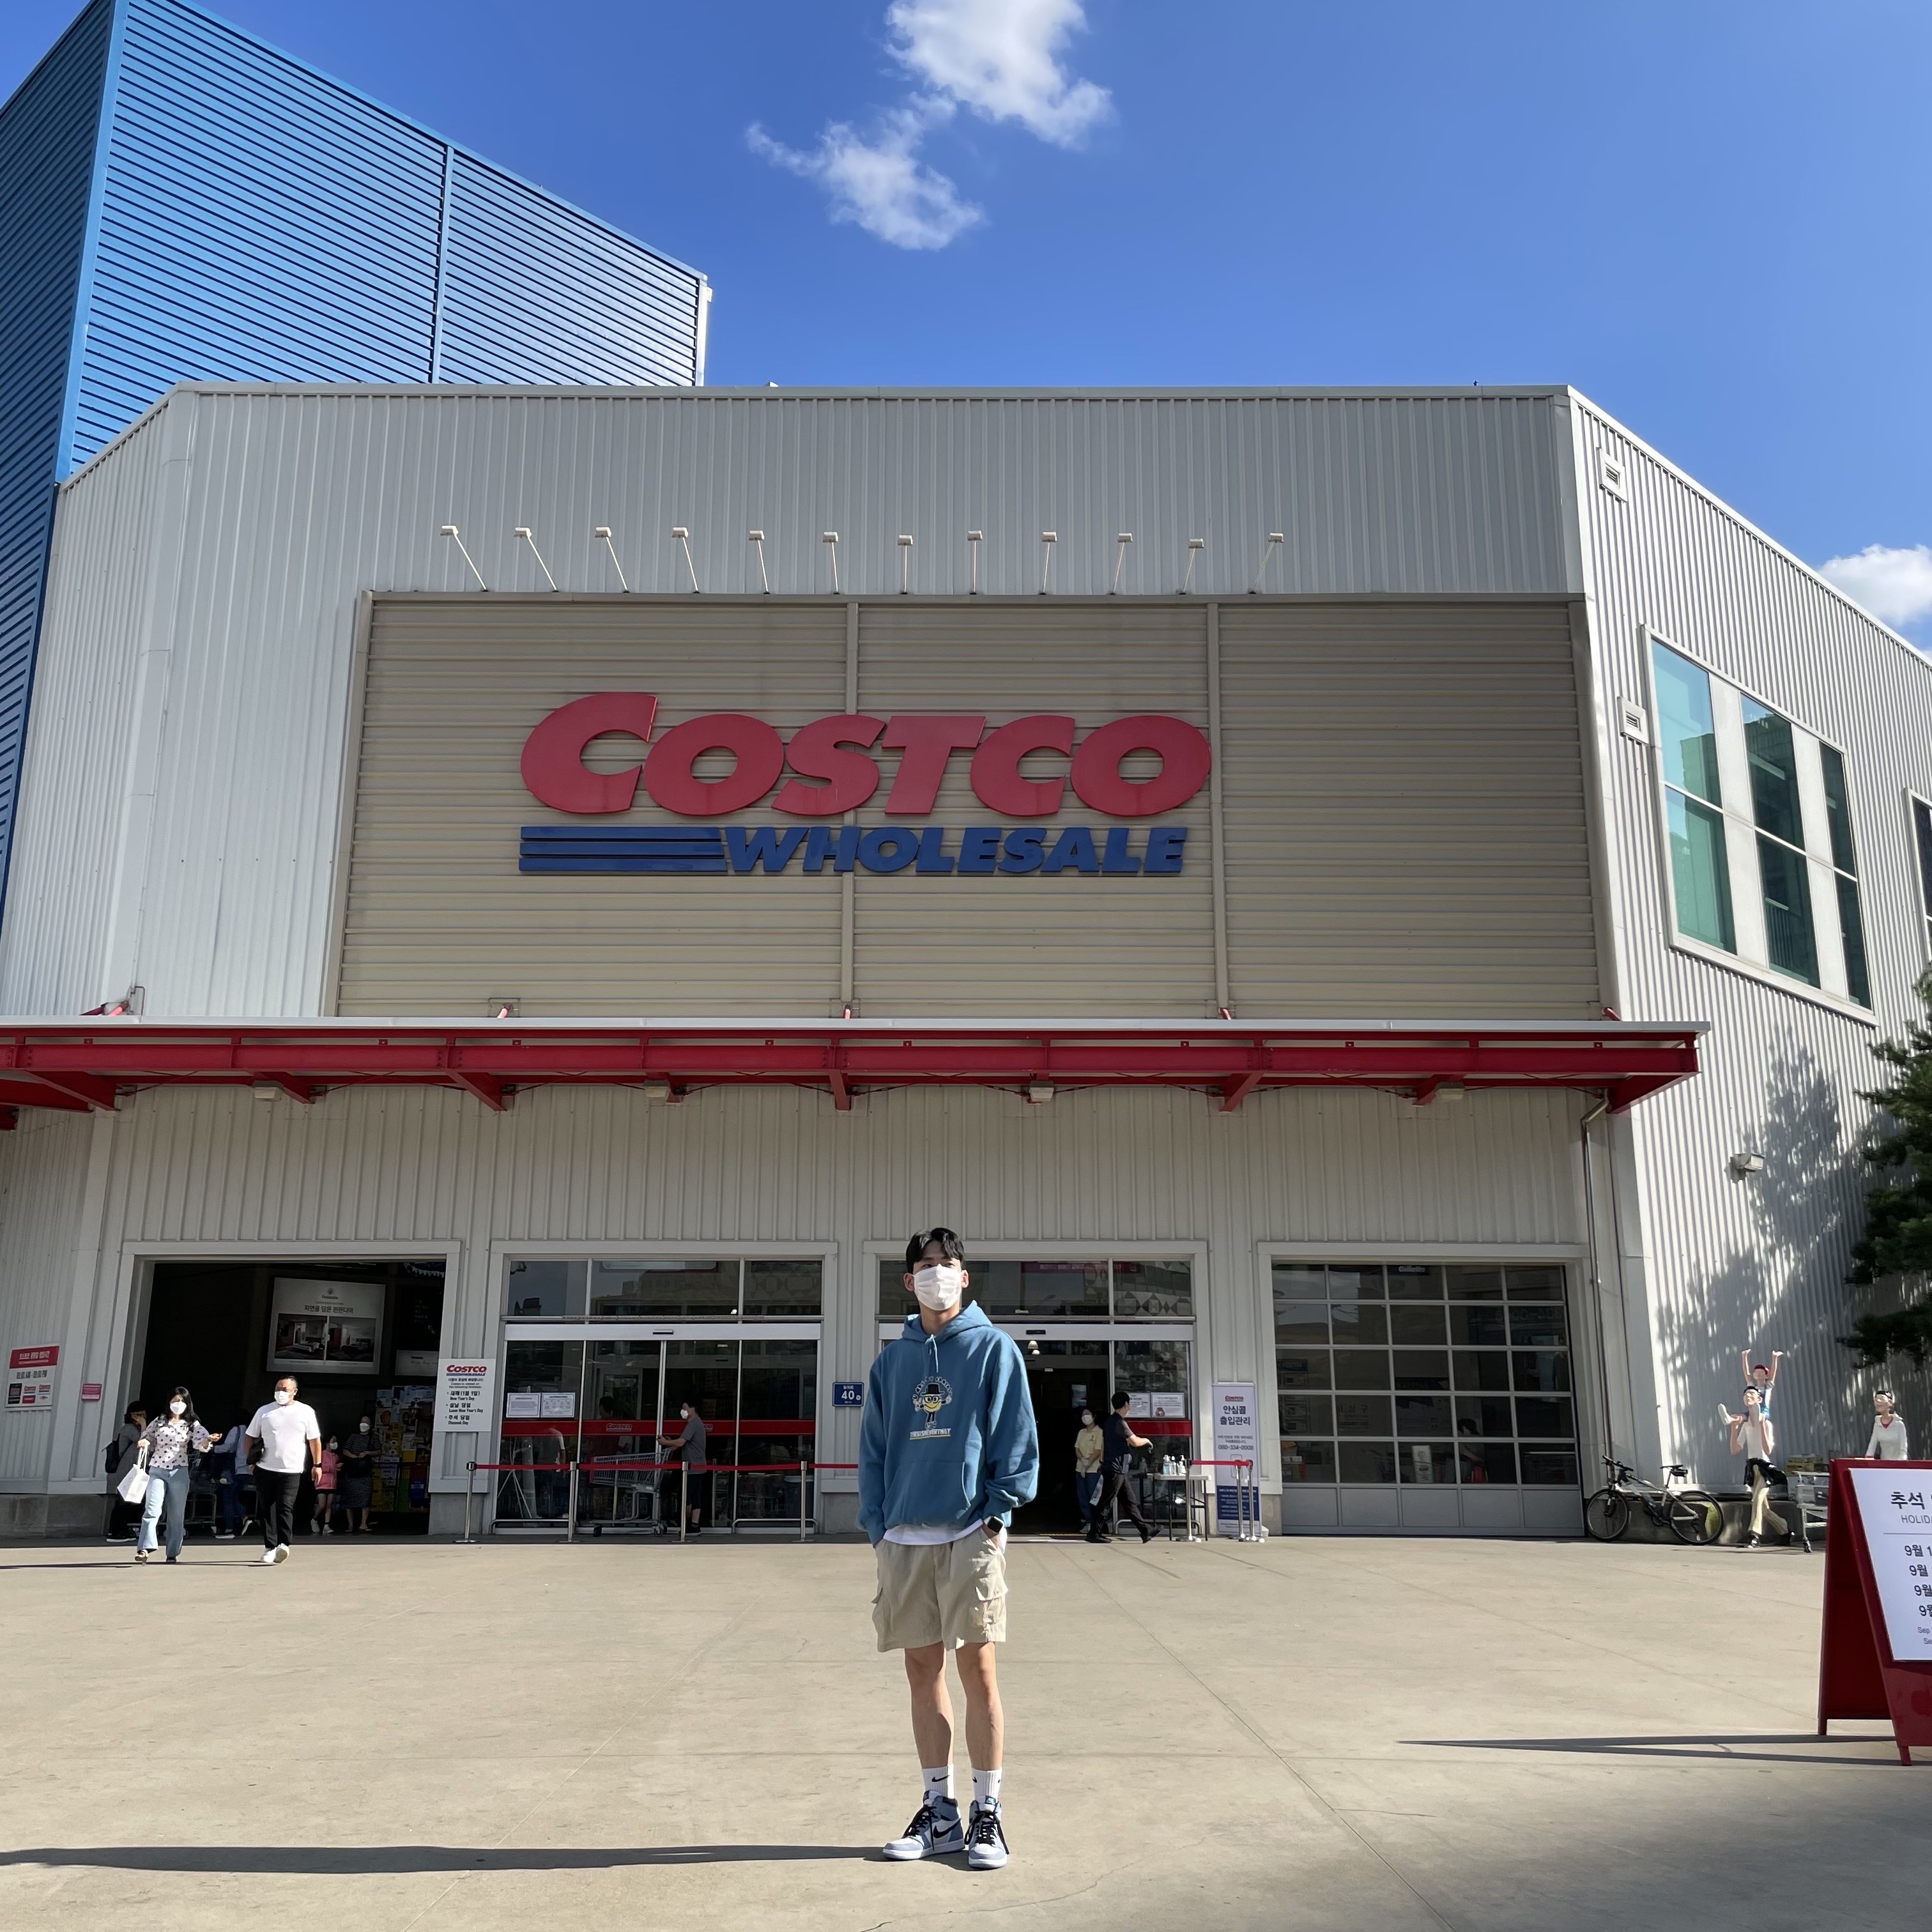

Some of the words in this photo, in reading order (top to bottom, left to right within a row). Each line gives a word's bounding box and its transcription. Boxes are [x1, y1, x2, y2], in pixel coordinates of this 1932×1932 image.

[520, 692, 1211, 817] COSTCO
[724, 826, 1188, 873] WHOLESALE
[841, 1390, 854, 1399] 40
[1890, 1492, 1924, 1510] 추석
[1901, 1515, 1932, 1524] HOLID
[1905, 1544, 1924, 1557] 9월
[1909, 1565, 1928, 1577] 9월
